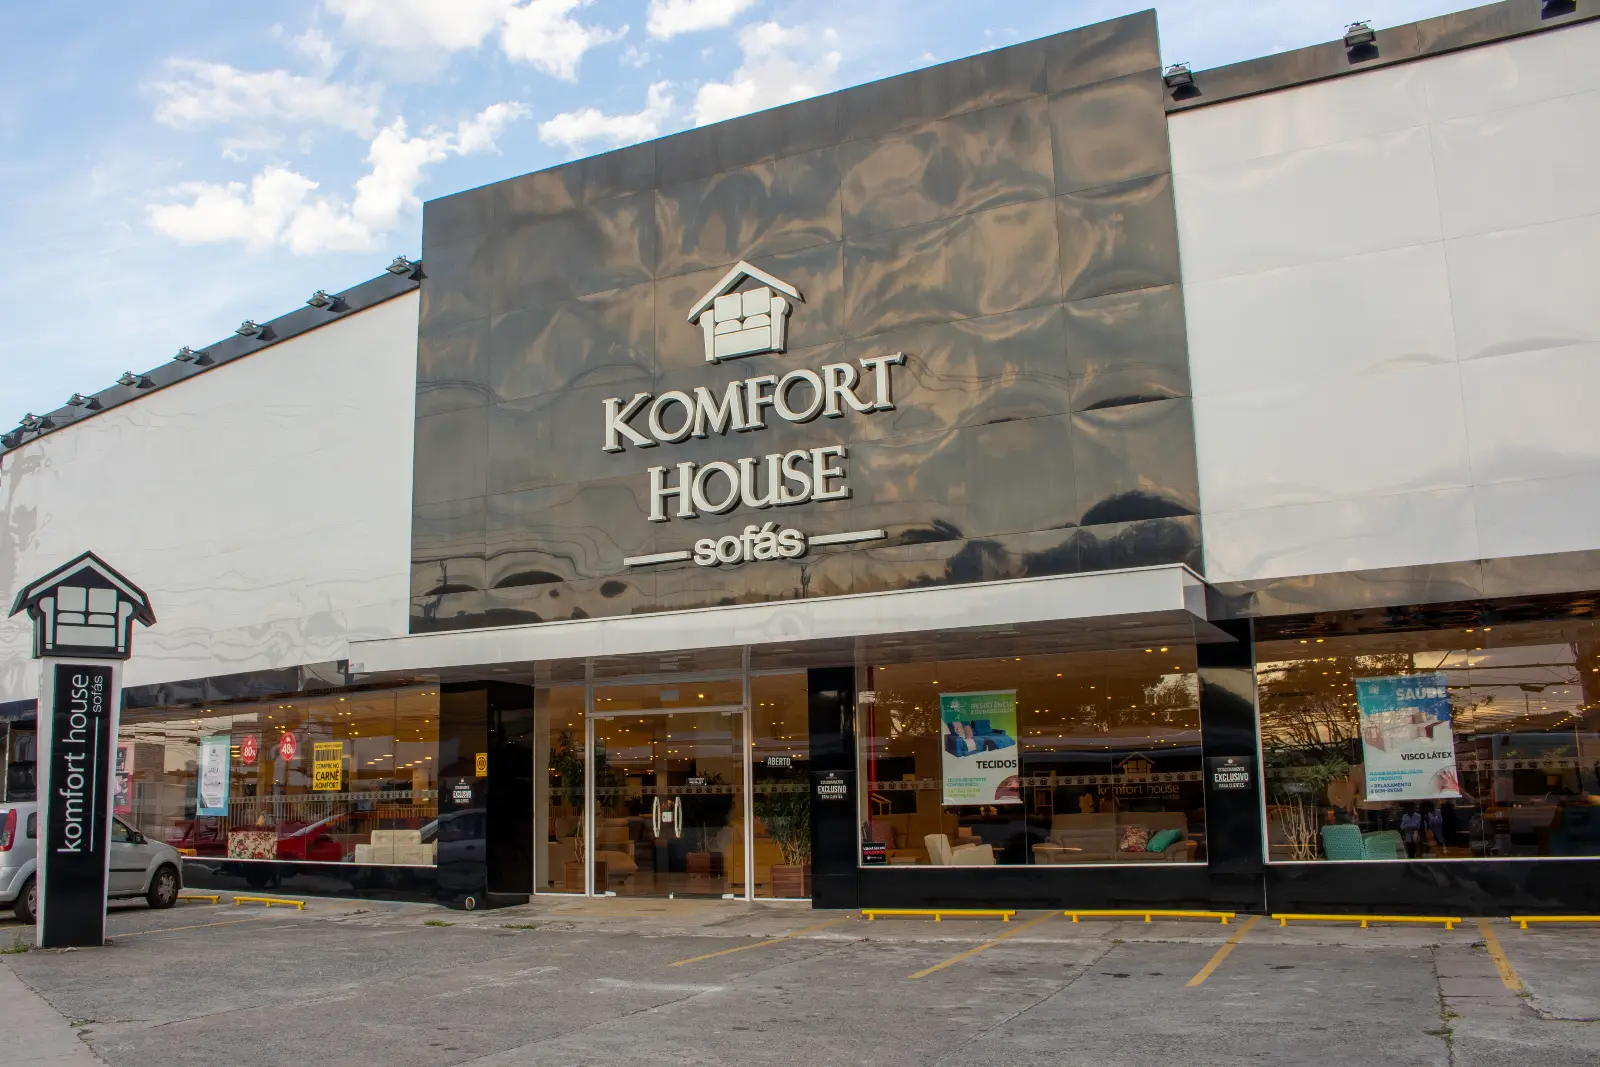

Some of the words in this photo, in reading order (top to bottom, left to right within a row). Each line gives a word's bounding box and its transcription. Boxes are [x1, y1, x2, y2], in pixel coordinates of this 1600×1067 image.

[602, 352, 906, 452] KOMFORT
[647, 445, 851, 521] HOUSE
[693, 522, 806, 567] sofás
[92, 675, 103, 713] sofás
[1395, 685, 1446, 700] SAÚDE
[62, 674, 89, 742] house
[1400, 752, 1426, 760] VISCO
[1427, 750, 1453, 760] LÁTEX
[767, 757, 791, 767] ABERTO
[976, 759, 1017, 769] TECIDOS
[315, 769, 339, 781] CARNÊ
[1214, 773, 1249, 782] EXCLUSIVO
[818, 785, 847, 793] EXCLUSIVO
[1147, 782, 1180, 794] house
[57, 752, 85, 852] komfort
